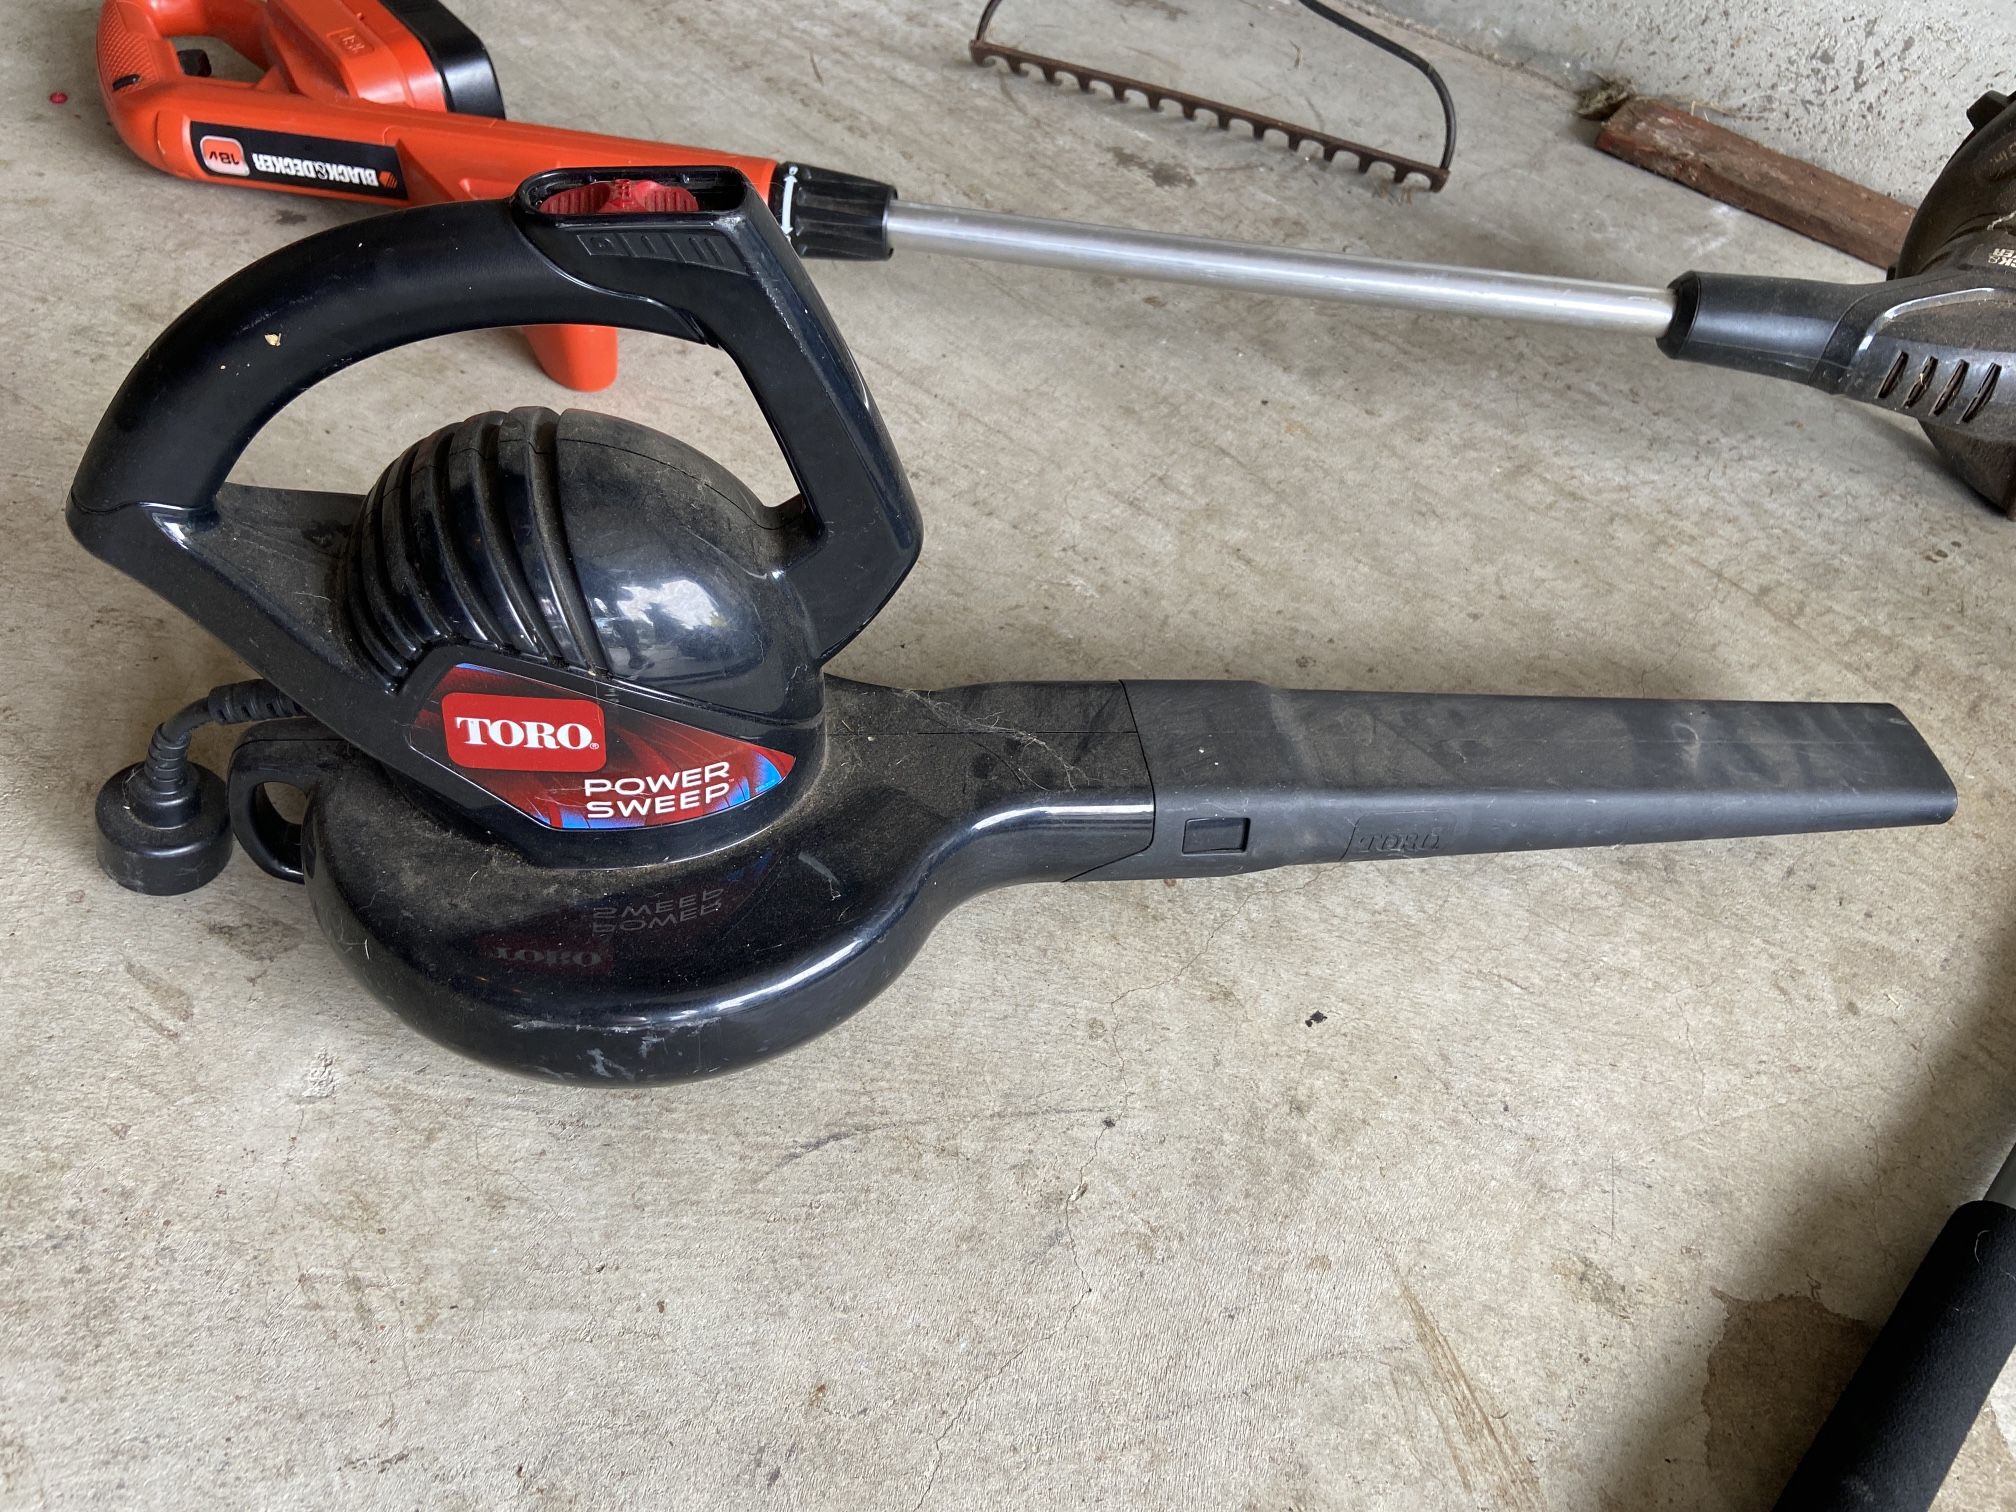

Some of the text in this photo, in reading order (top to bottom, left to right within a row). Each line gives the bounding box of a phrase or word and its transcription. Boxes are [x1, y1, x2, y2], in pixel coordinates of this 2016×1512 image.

[252, 153, 379, 187] BLACK&DECKER
[585, 761, 730, 797] POWER
[587, 782, 730, 818] SWEEP
